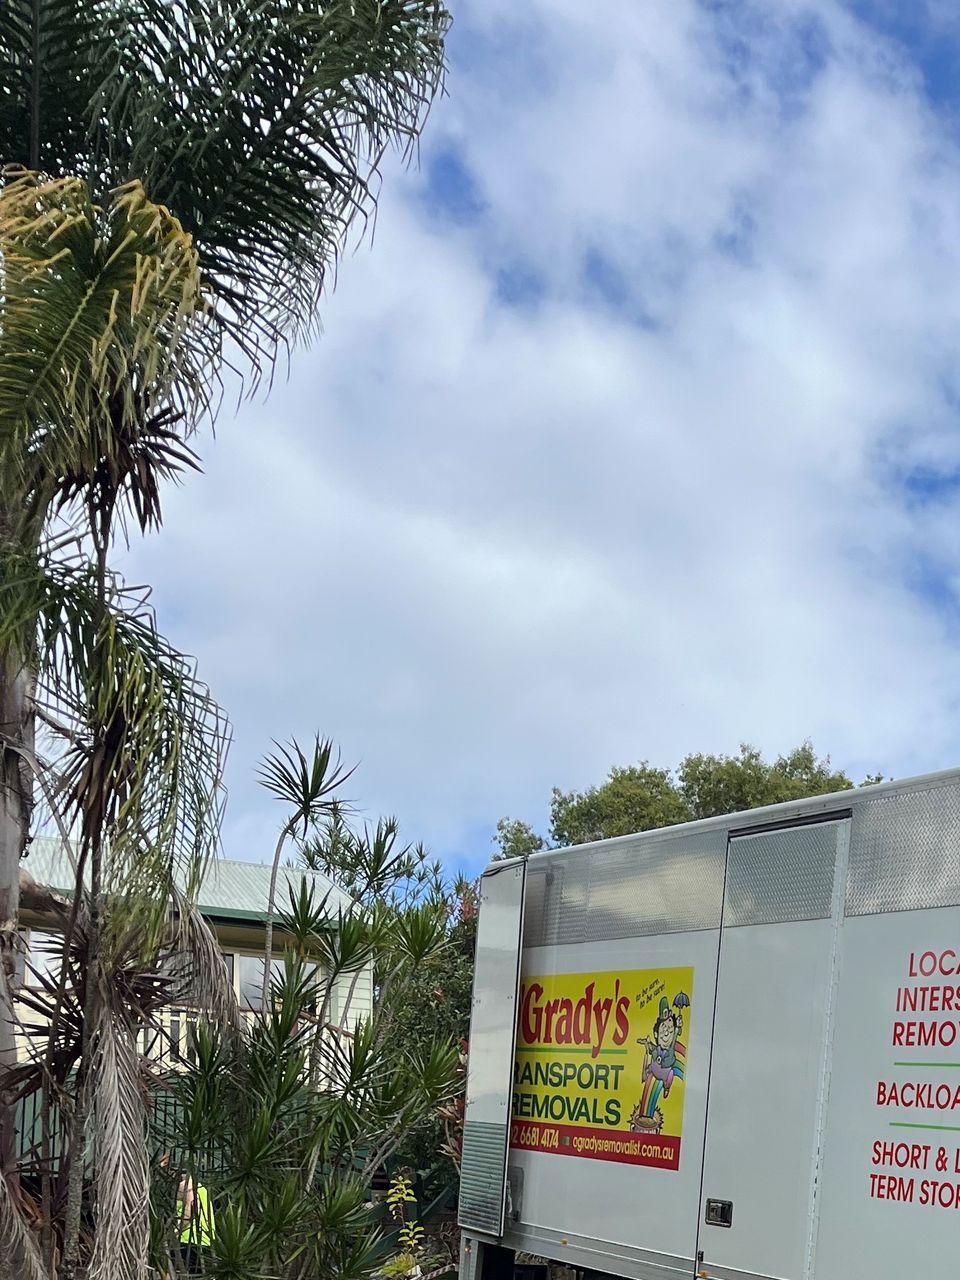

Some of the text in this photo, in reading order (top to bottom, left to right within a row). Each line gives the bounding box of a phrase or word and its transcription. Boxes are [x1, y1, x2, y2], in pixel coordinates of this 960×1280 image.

[516, 979, 630, 1059] 'Grady's
[514, 1062, 624, 1090] RANSPORT
[510, 1126, 674, 1160] 2 6681 4174 ogradysremovalist.com.au
[872, 1140, 931, 1170] SHORT
[936, 1147, 949, 1172] &
[870, 1174, 915, 1203] TERM
